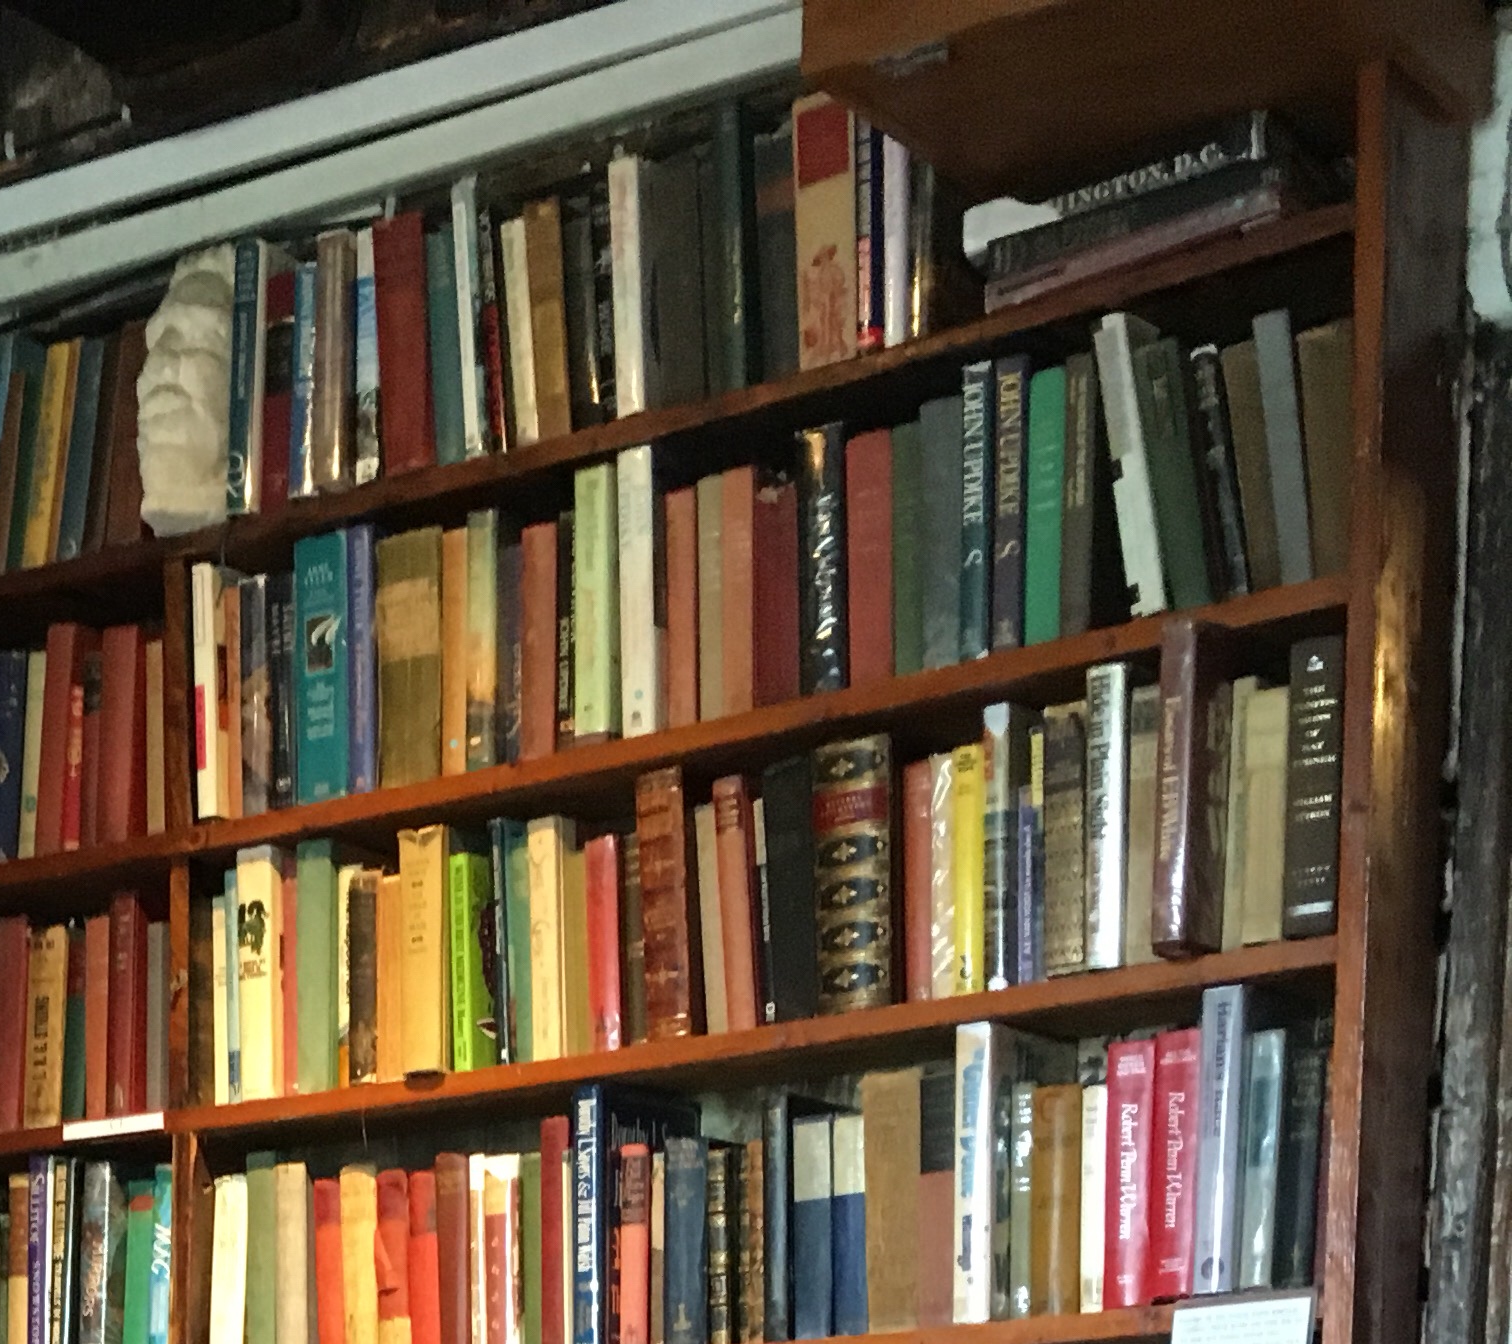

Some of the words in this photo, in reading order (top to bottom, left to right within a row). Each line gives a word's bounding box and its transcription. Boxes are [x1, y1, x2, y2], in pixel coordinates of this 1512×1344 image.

[964, 381, 985, 437] JOHN
[999, 373, 1022, 431] JOHN
[963, 439, 985, 527] UPDIKE
[999, 433, 1022, 516] UPDIKE
[1120, 1103, 1139, 1147] Robert
[1167, 1091, 1186, 1136] Robert
[1119, 1148, 1138, 1183] Penn
[1165, 1136, 1184, 1173] Penn
[1118, 1183, 1138, 1240] Warren
[1163, 1173, 1183, 1230] Warren
